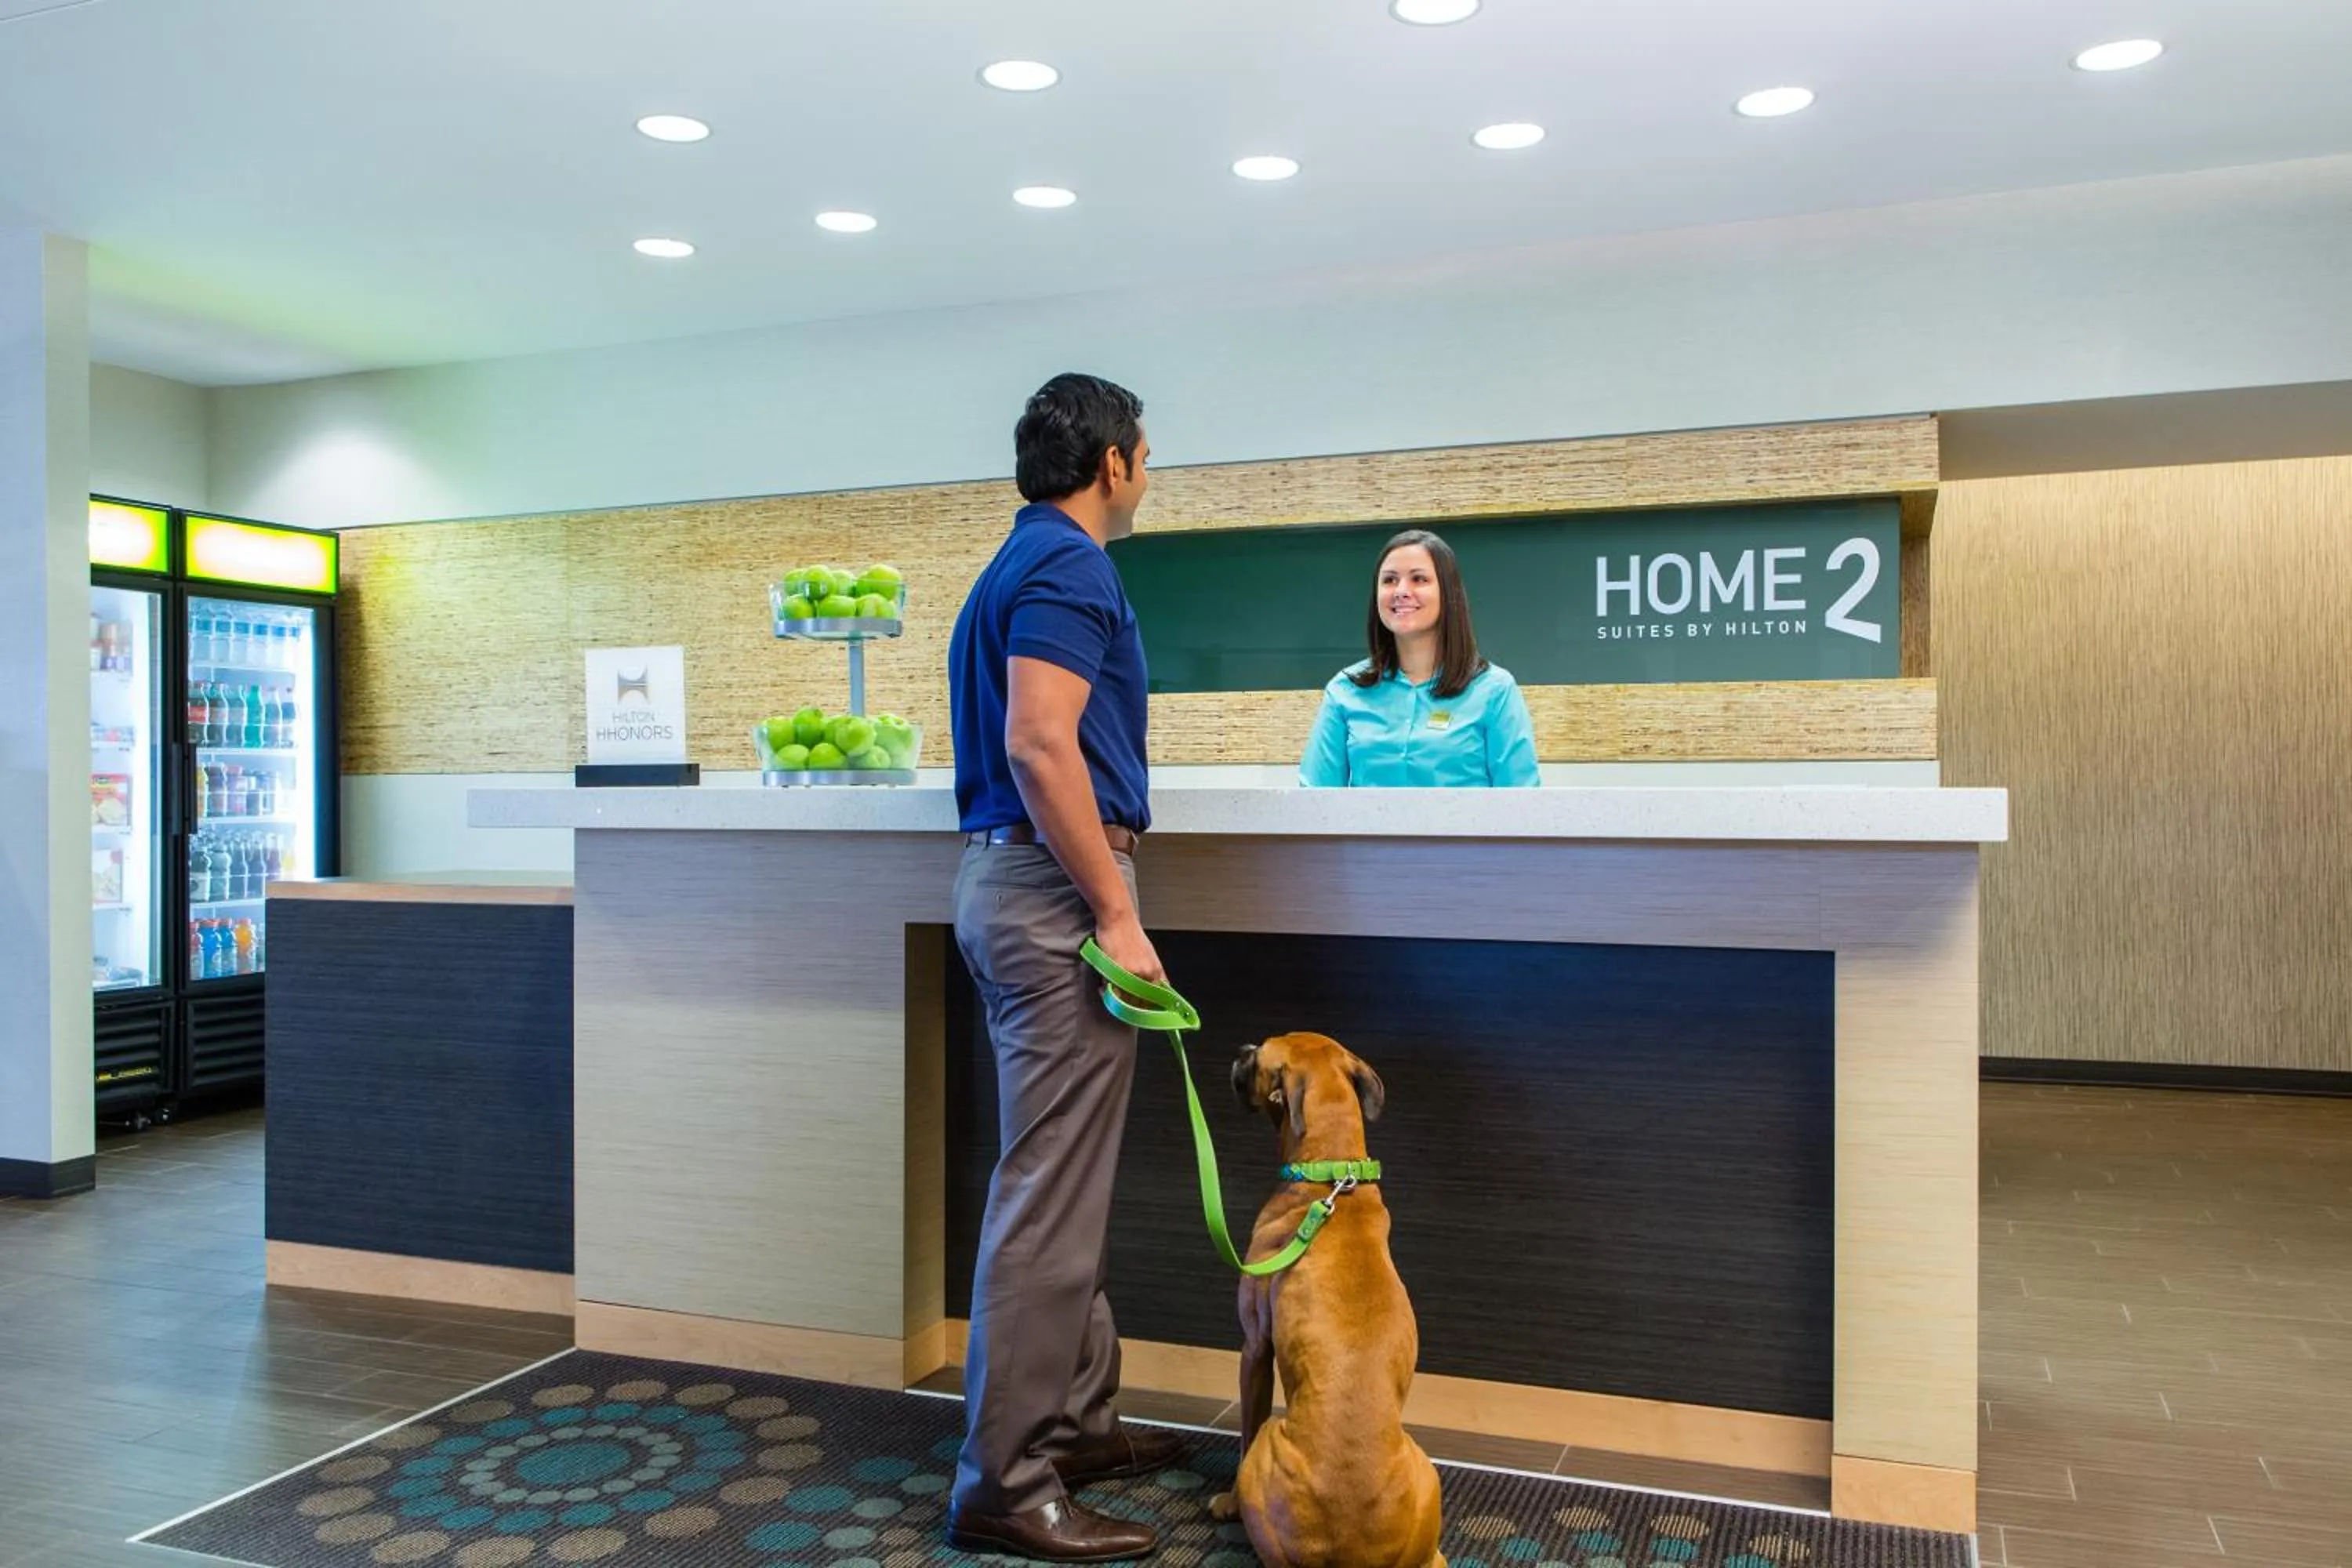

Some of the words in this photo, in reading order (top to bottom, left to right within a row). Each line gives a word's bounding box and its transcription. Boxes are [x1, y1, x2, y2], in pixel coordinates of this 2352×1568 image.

[1596, 547, 1806, 616] HOME
[1824, 537, 1881, 643] 2
[1597, 624, 1675, 639] SUITES
[1687, 622, 1712, 637] BY
[1726, 619, 1807, 635] HILTON
[596, 725, 673, 741] HHONORS
